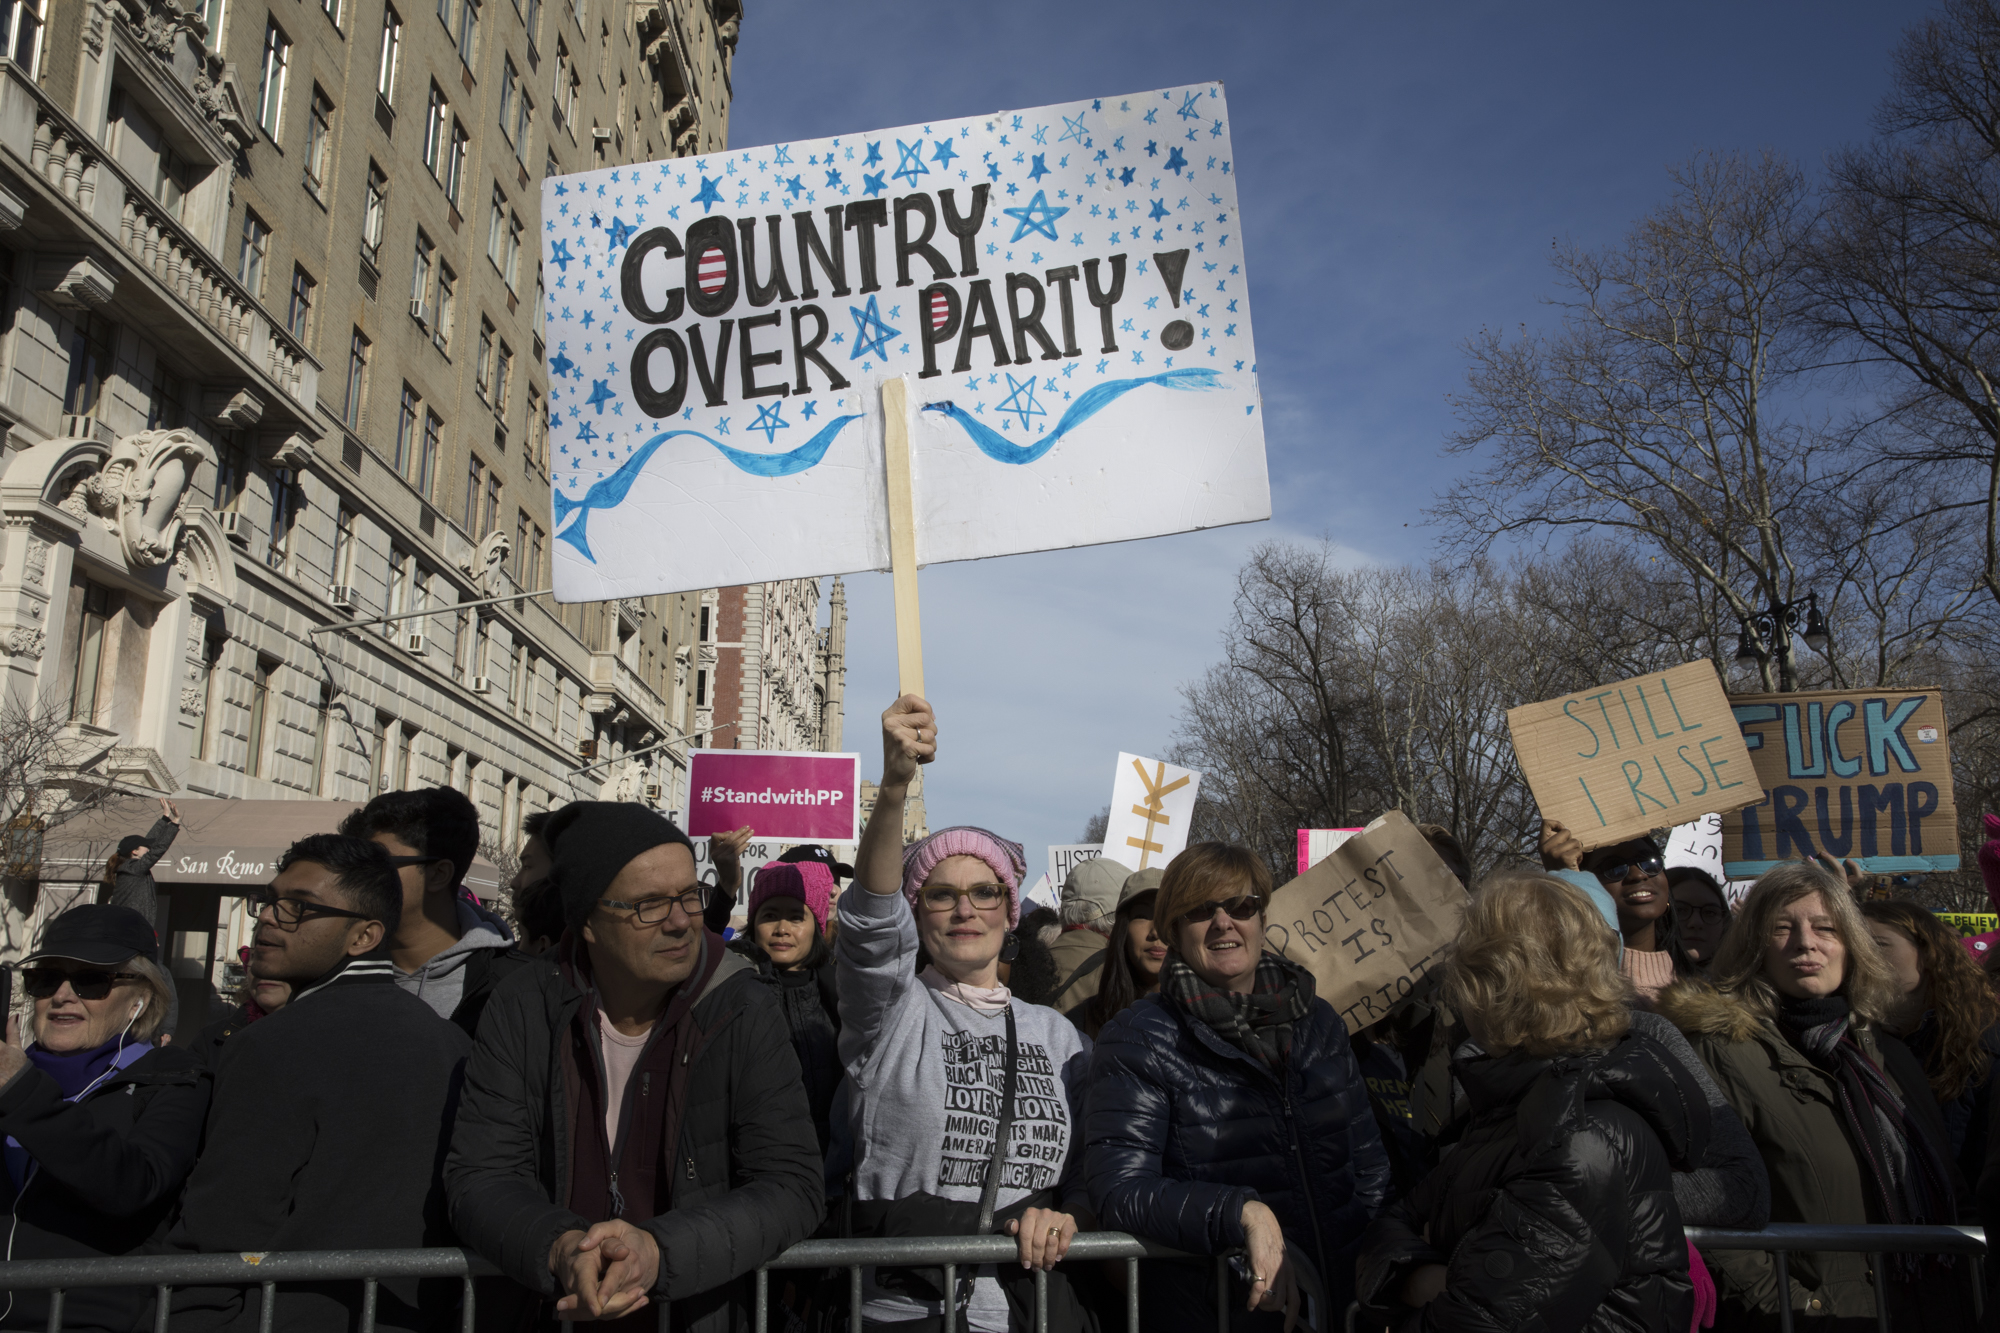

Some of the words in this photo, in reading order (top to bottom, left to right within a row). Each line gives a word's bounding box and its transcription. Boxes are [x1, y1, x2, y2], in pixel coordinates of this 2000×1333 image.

[620, 183, 991, 324] COUNTRY
[630, 304, 851, 418] OVER
[1563, 678, 1702, 759] STILL
[1730, 695, 1928, 779] FUCK
[700, 786, 844, 806] #StandwithPP
[1577, 776, 1607, 827] I
[1621, 735, 1744, 816] RISE
[1741, 780, 1939, 861] TRUMP
[176, 856, 208, 874] San
[216, 849, 265, 879] Remo
[1341, 917, 1393, 964] IS
[945, 1062, 984, 1086] BLACK
[945, 1087, 992, 1115] LOVE
[1013, 1097, 1067, 1121] LOVE
[944, 1115, 1026, 1140] IMMIGRTS
[1033, 1124, 1066, 1147] MAKE
[940, 1158, 983, 1185] CLIMATE
[1017, 1143, 1064, 1164] GREAT
